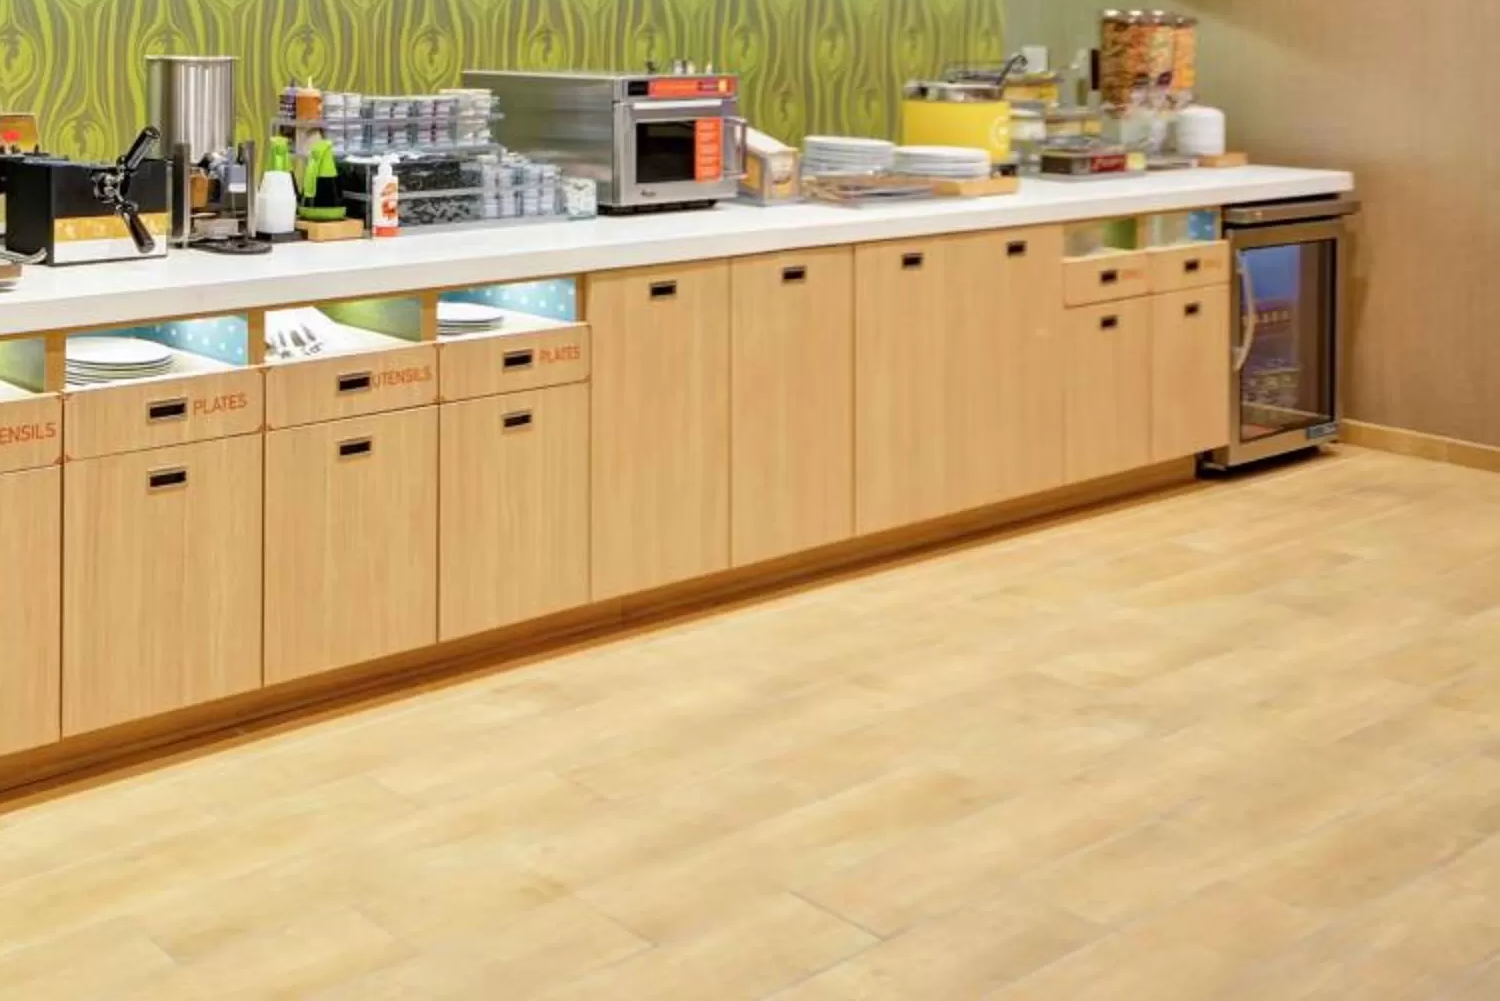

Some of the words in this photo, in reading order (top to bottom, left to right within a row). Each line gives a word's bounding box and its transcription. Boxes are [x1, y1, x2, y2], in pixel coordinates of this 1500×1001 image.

[538, 344, 582, 366] PLATES
[372, 365, 433, 391] UTENSILS
[192, 393, 248, 416] PLATES
